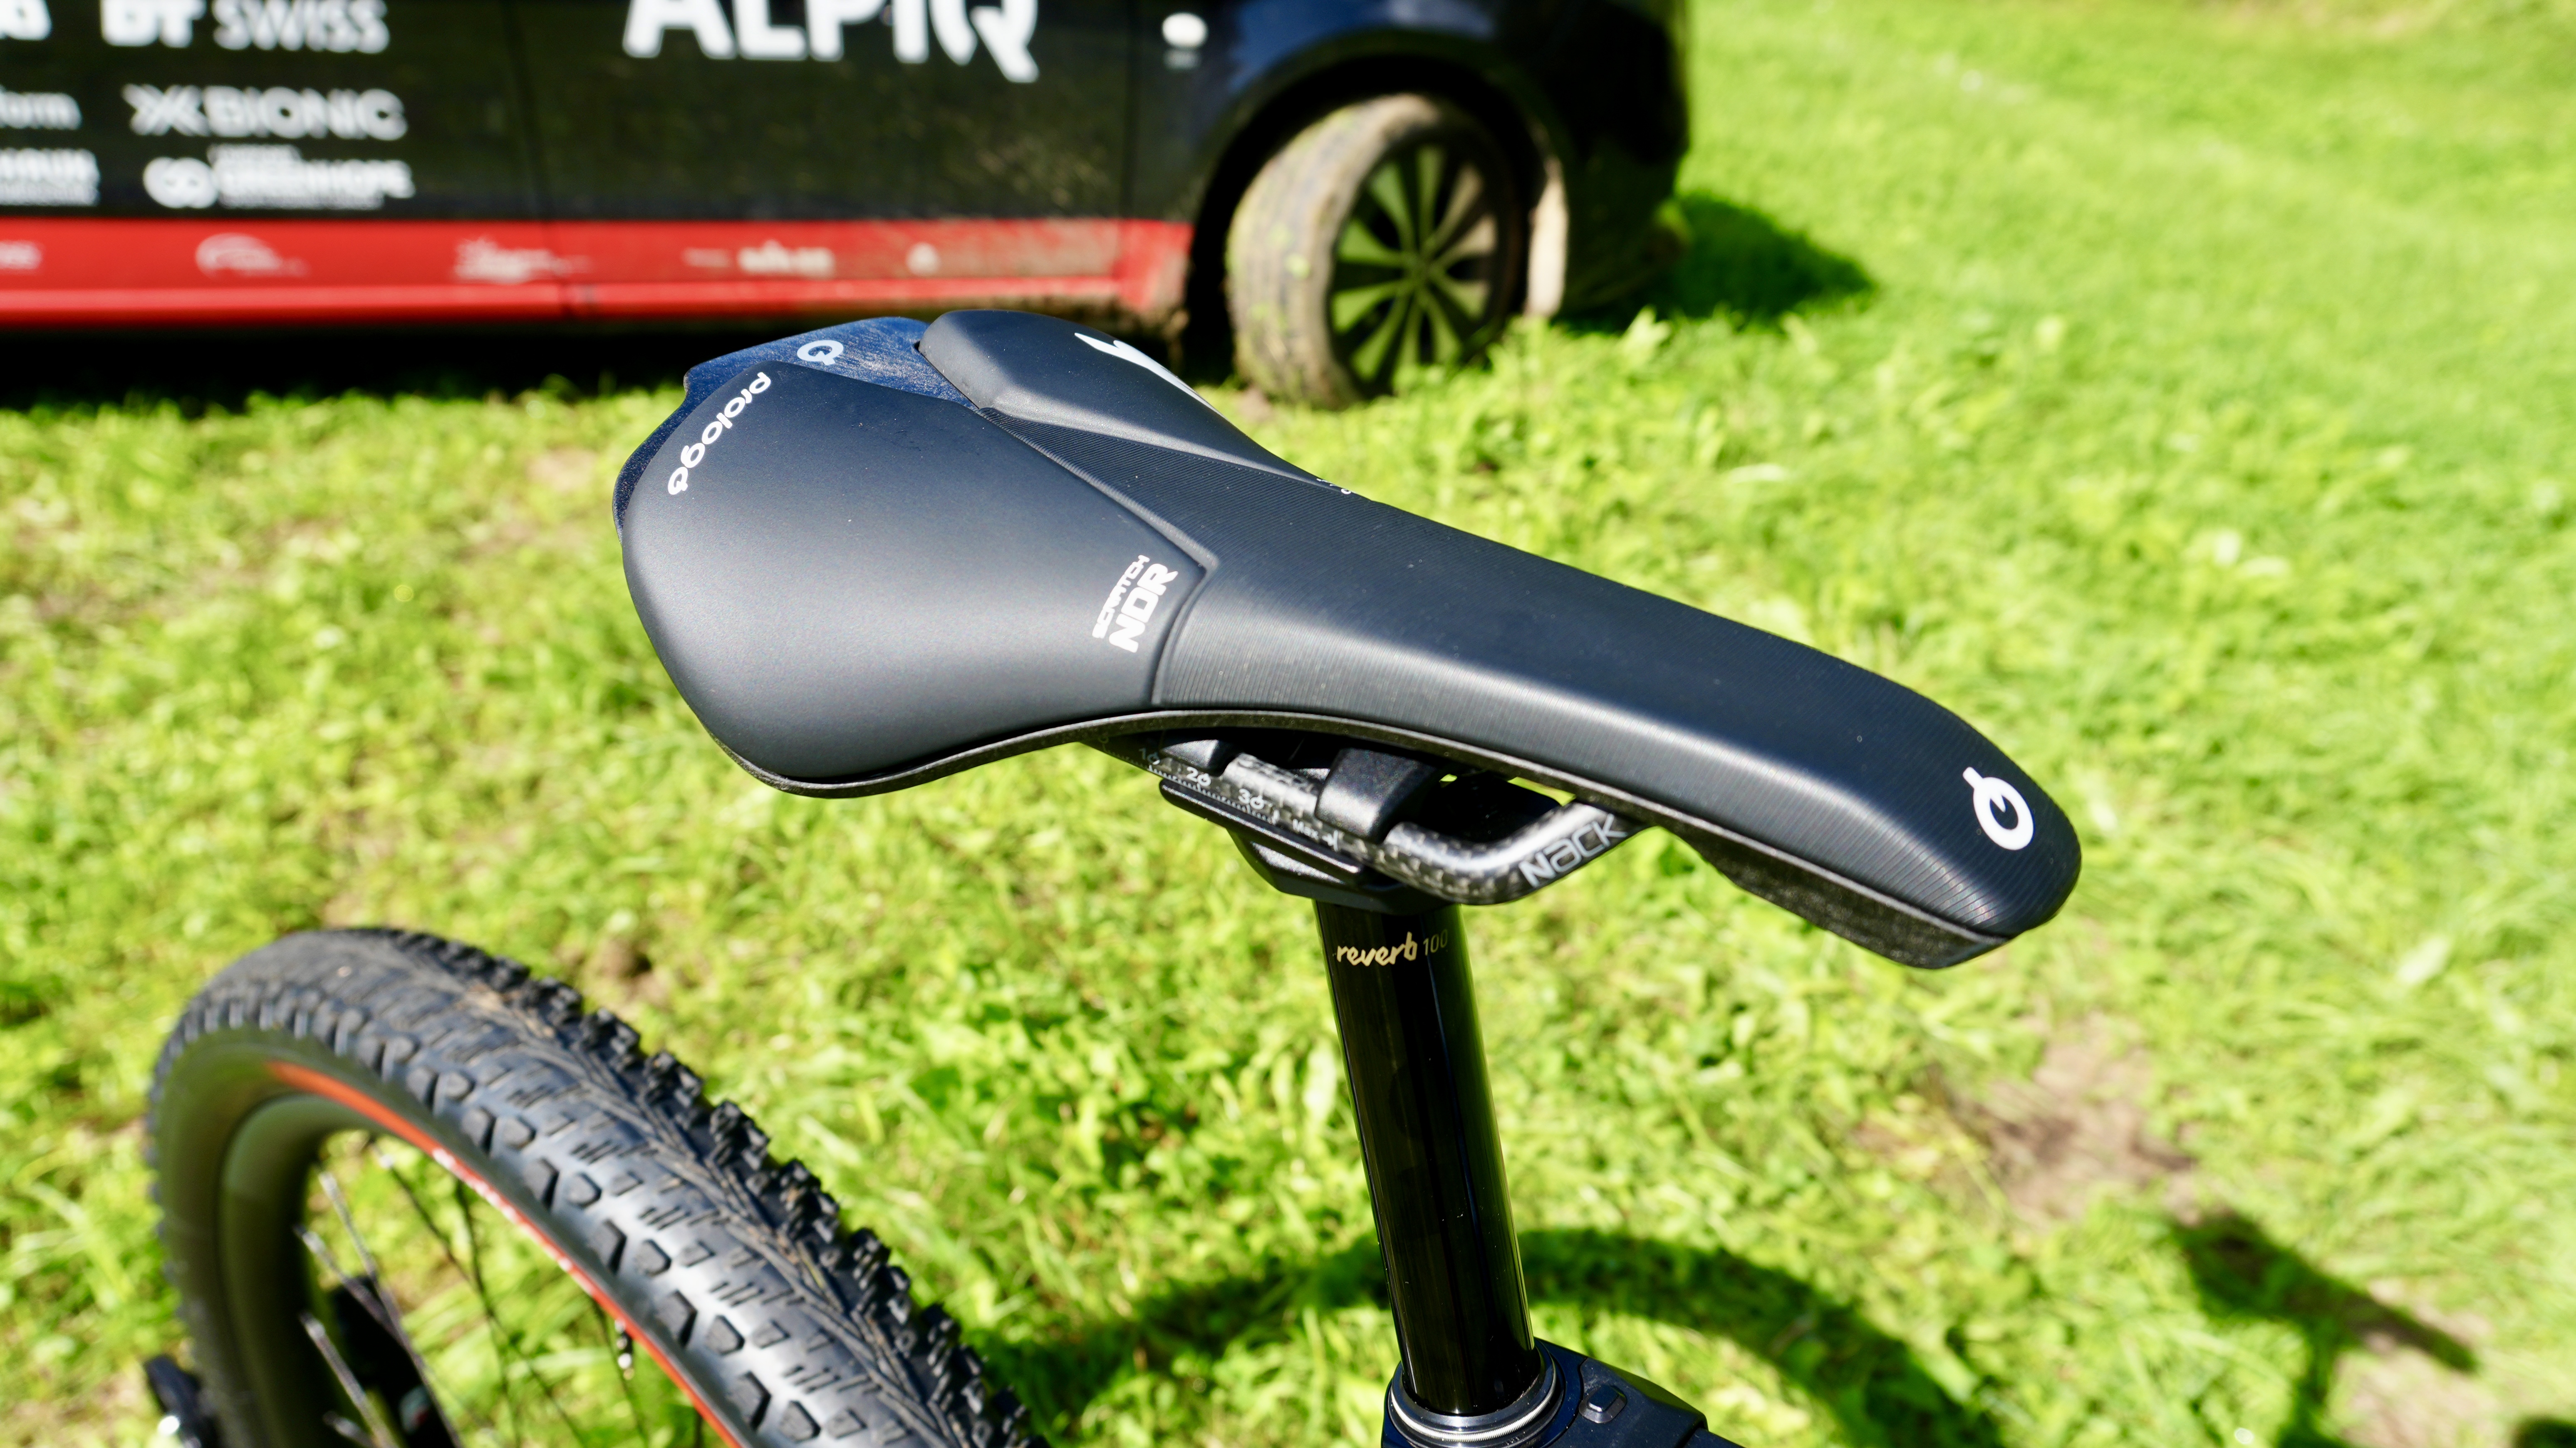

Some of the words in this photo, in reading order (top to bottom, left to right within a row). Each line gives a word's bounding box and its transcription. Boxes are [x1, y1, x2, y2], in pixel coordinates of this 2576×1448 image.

[213, 0, 389, 53] SWISS
[1092, 555, 1149, 638] SCRATCH
[1109, 563, 1178, 652] NDR
[1186, 766, 1211, 787] 20
[1238, 788, 1264, 809] 30
[1337, 931, 1417, 966] reverb
[1423, 929, 1448, 956] 100
